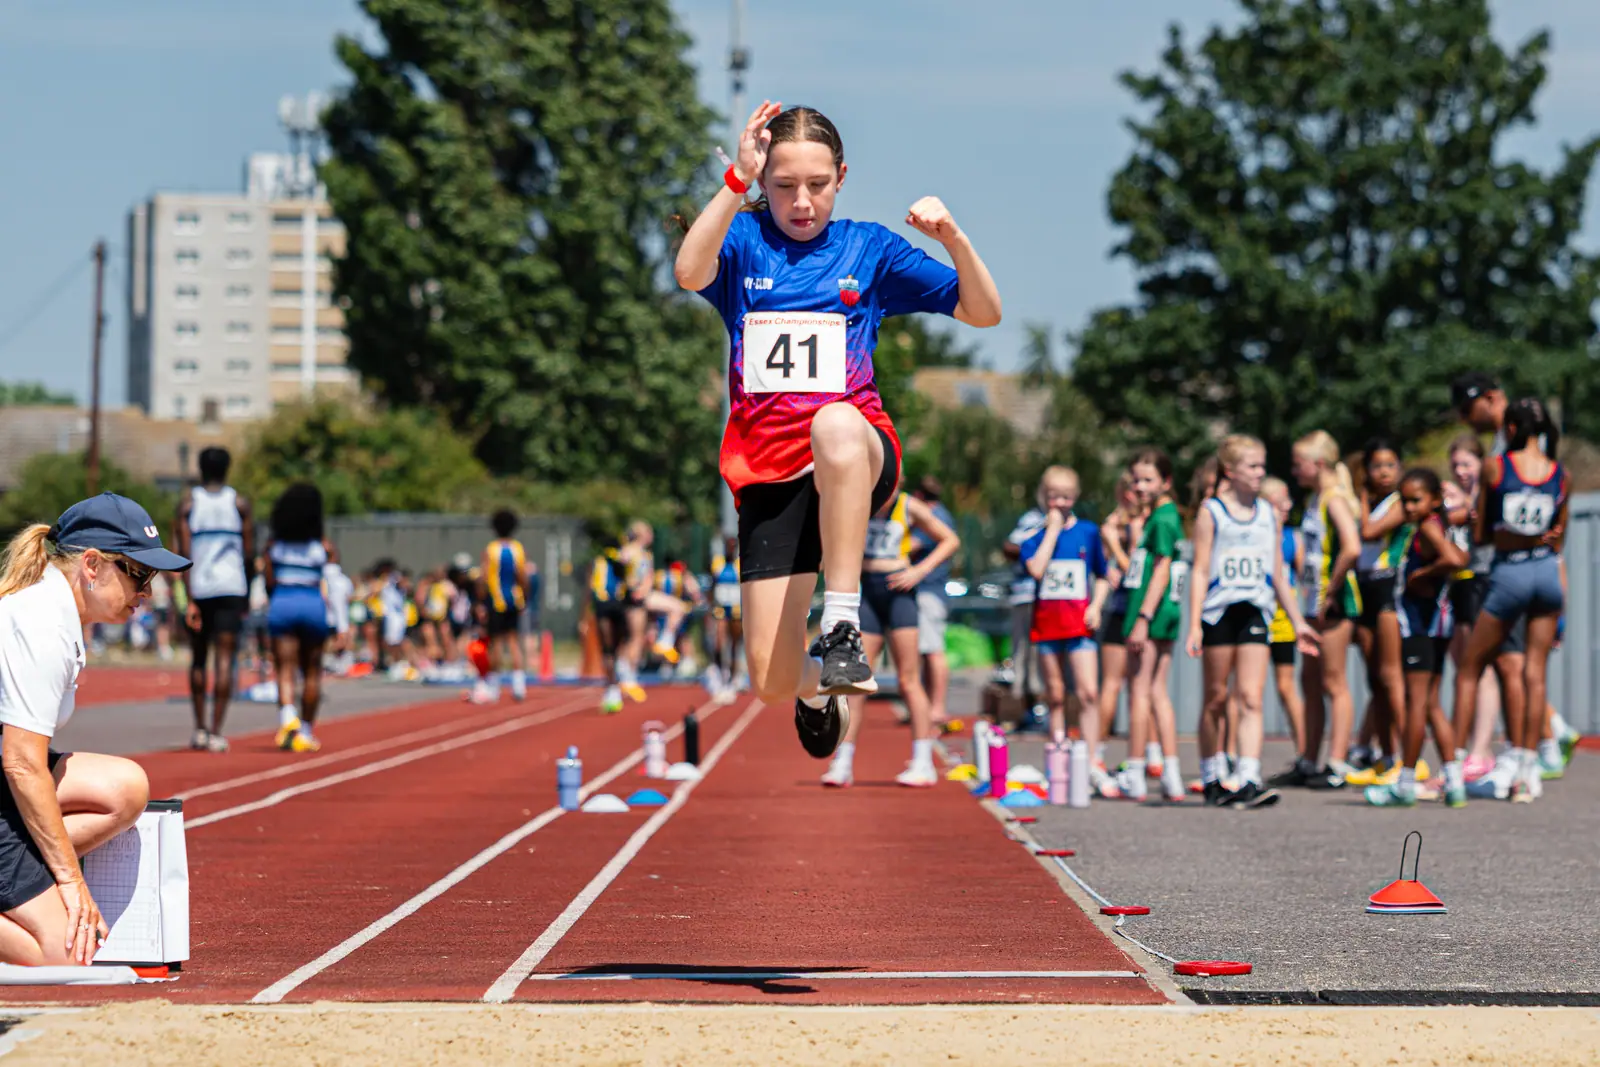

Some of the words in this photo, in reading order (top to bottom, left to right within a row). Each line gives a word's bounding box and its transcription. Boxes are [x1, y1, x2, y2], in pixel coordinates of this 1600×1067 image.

[749, 317, 772, 326] Essex
[774, 317, 841, 327] Championships
[766, 333, 818, 379] 41
[1224, 558, 1264, 580] 603
[1046, 569, 1075, 592] 54
